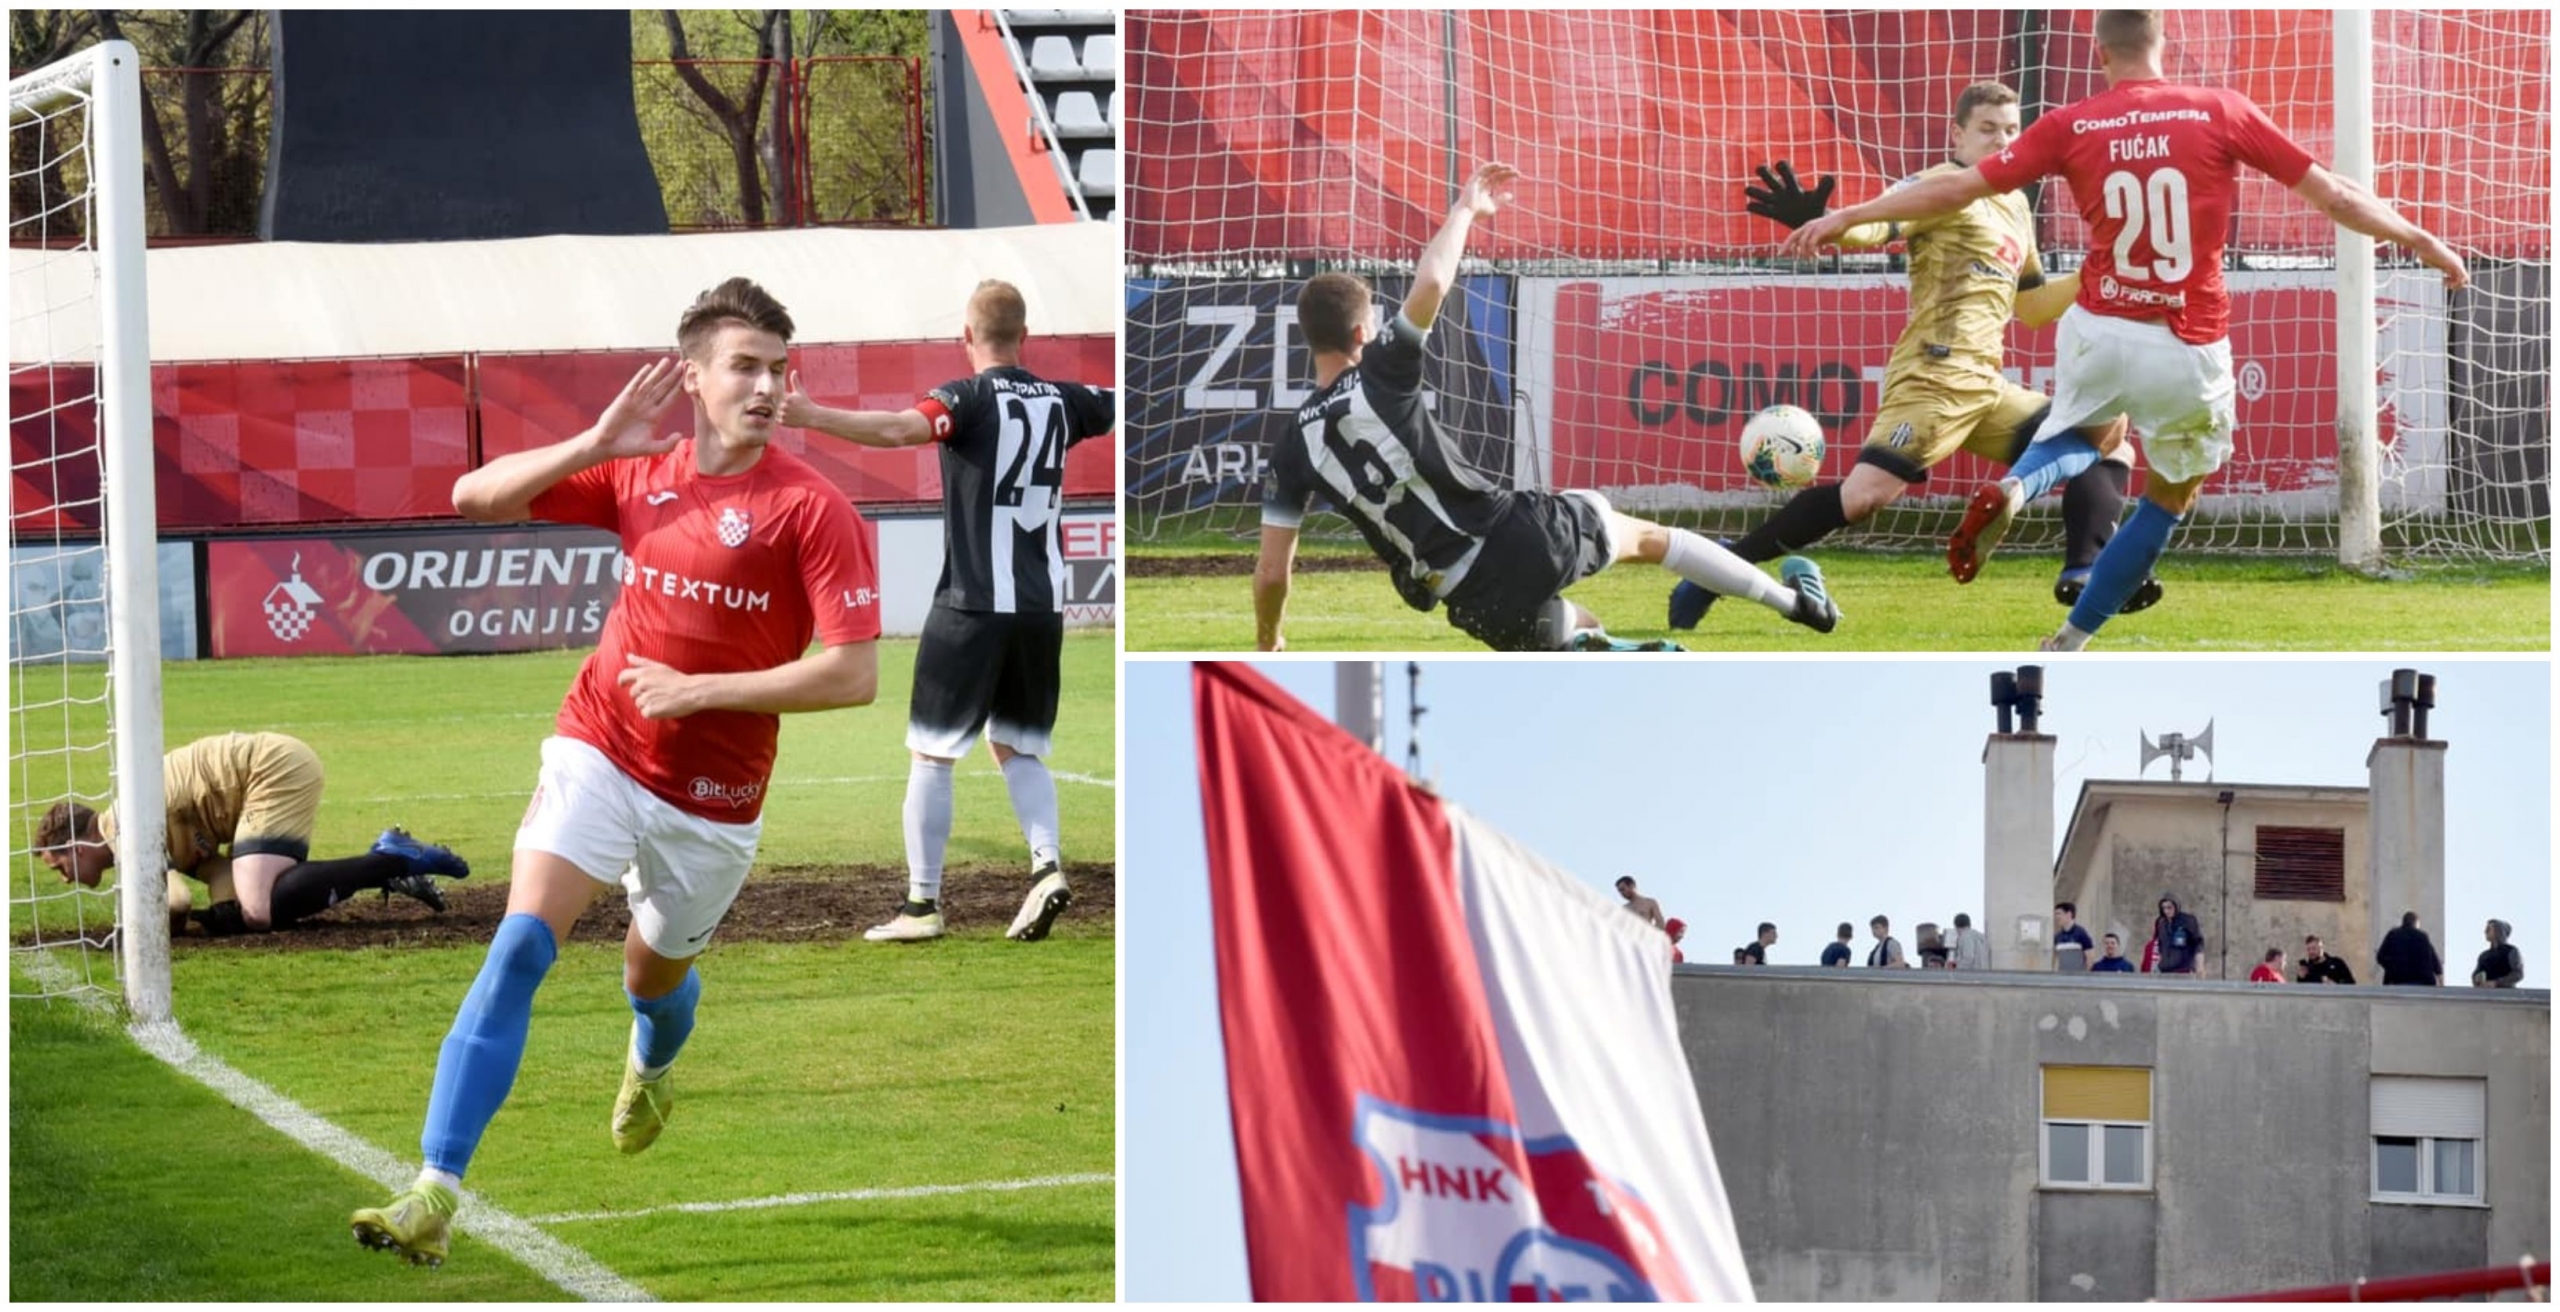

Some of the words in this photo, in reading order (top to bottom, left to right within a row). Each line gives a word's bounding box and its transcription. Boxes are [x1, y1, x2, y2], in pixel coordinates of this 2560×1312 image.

[2109, 132, 2171, 162] FUĆAK
[2103, 166, 2194, 283] 29
[994, 398, 1063, 509] 24
[641, 565, 770, 612] TEXTUM
[1398, 1155, 1513, 1203] HNK
